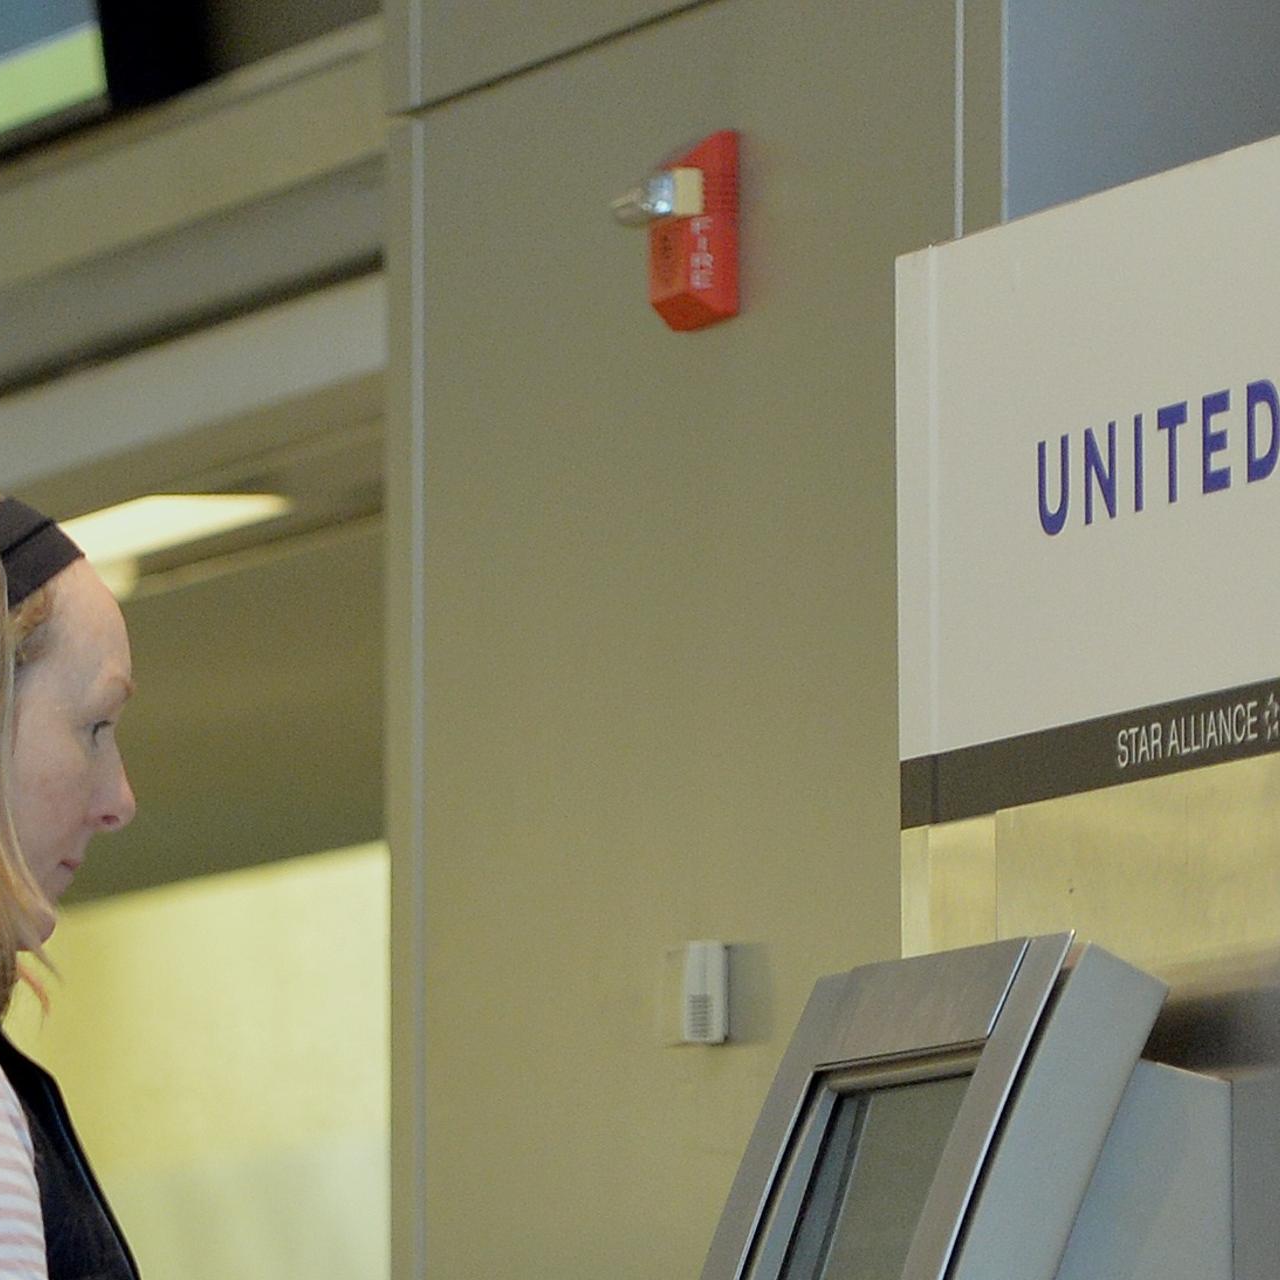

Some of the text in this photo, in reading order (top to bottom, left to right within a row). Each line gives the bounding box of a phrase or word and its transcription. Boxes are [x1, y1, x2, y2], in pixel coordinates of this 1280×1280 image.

[1037, 378, 1280, 536] UNITED
[1117, 701, 1258, 769] STAR ALLIANCE
